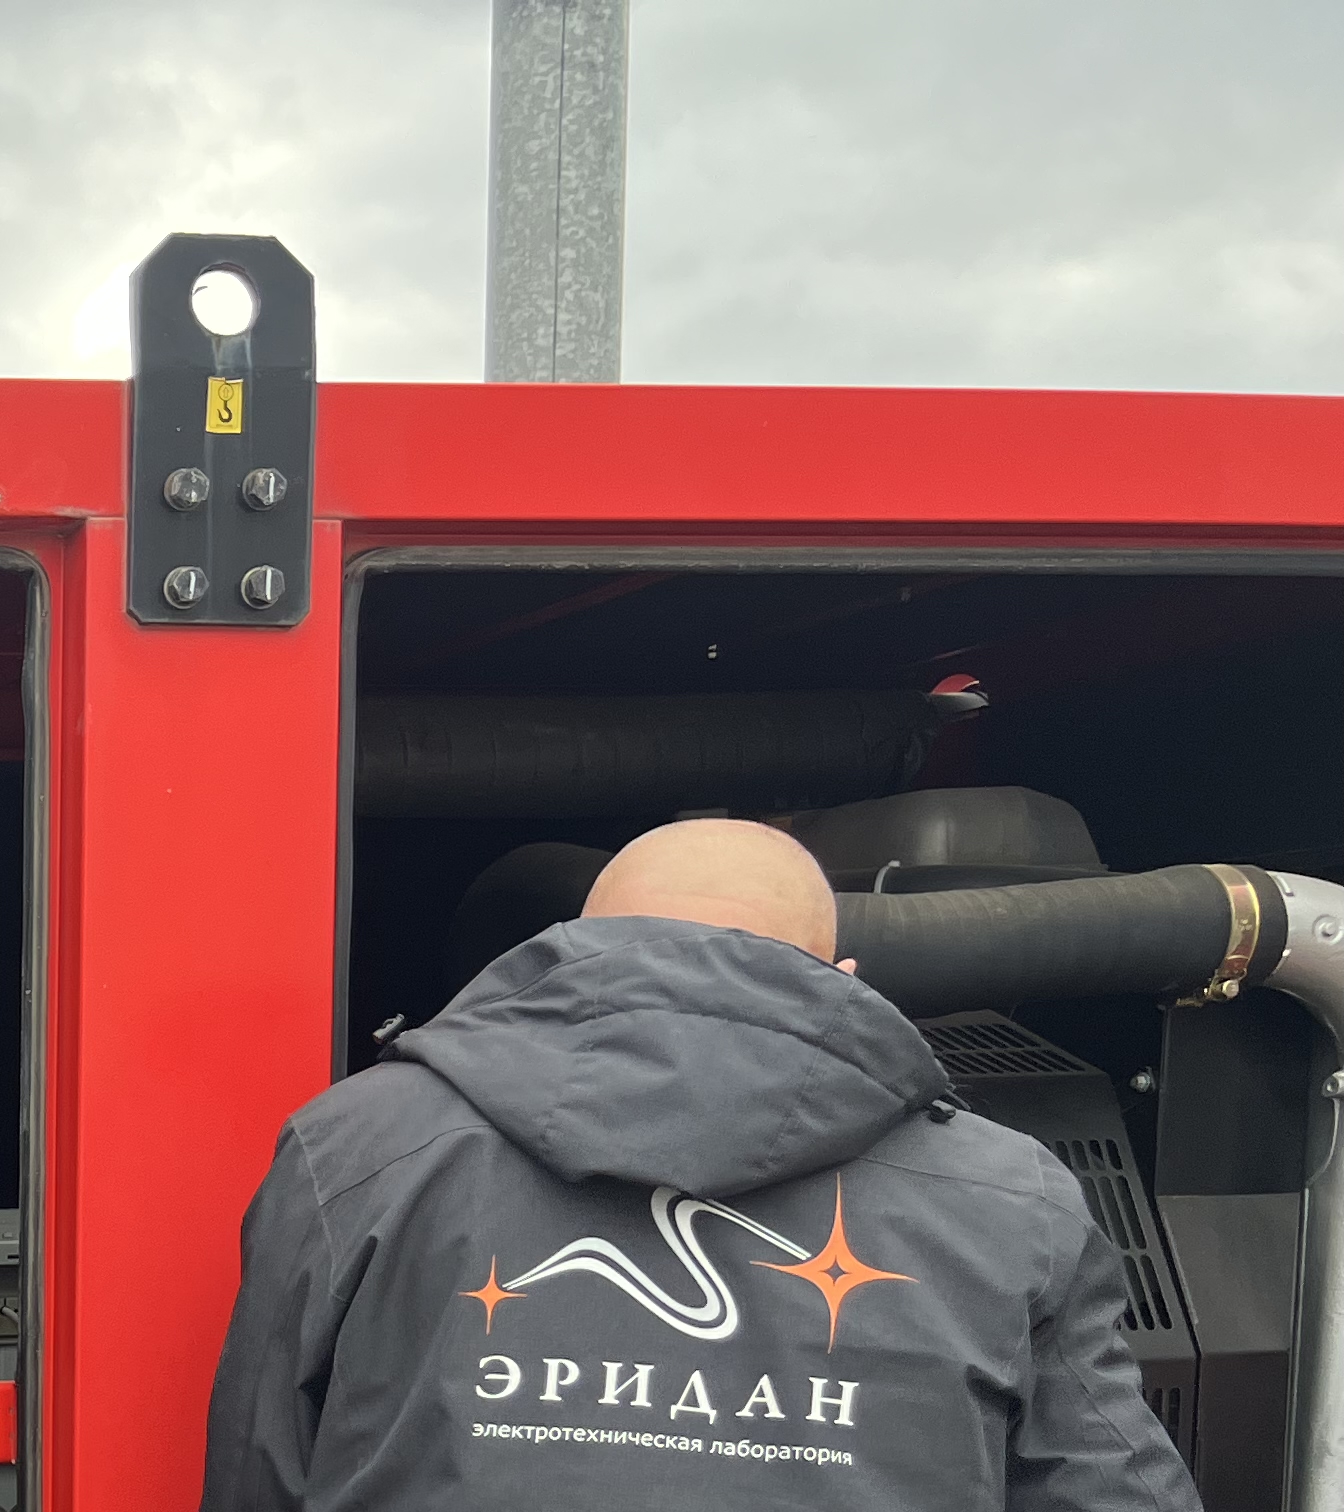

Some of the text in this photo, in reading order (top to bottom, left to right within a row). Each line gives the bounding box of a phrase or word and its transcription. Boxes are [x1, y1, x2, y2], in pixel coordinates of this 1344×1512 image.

[474, 1354, 860, 1427] ЭРИДАН
[471, 1422, 854, 1467] электротехническая лаборатория
